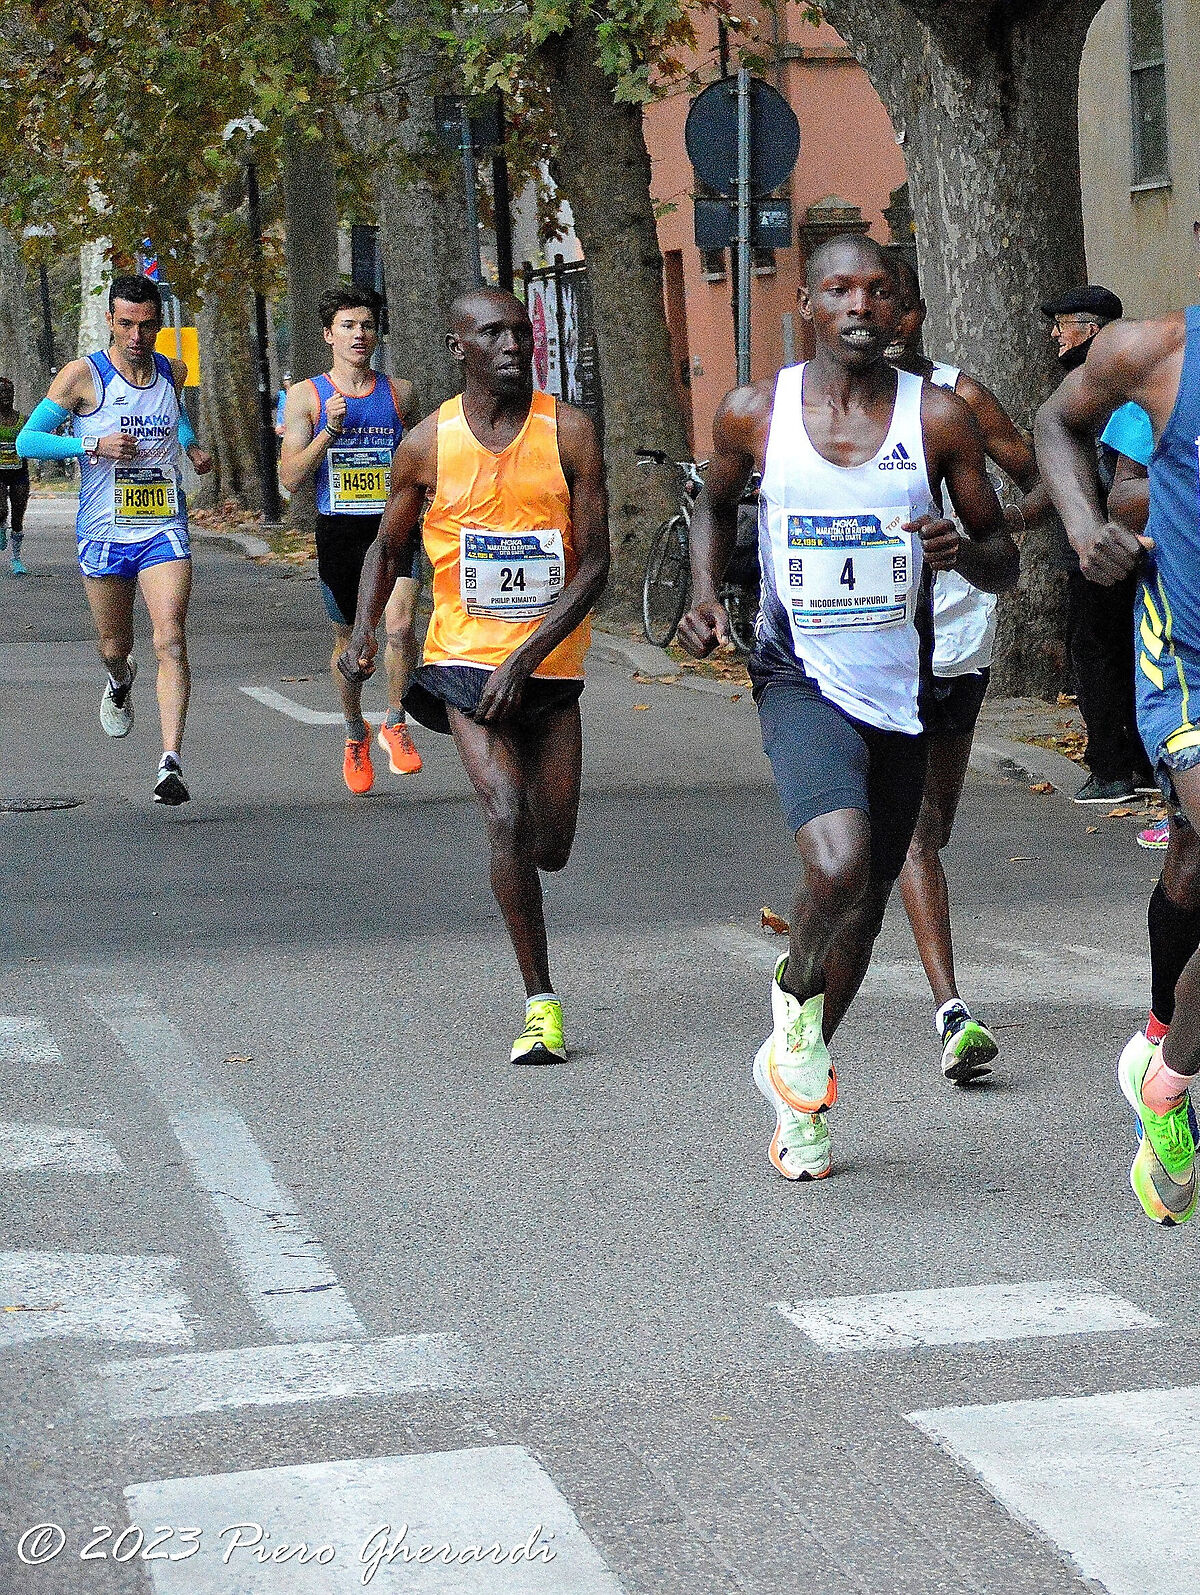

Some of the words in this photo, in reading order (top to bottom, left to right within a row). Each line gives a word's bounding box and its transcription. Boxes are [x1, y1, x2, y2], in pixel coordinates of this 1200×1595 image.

[120, 415, 170, 427] DINAMO
[878, 460, 917, 471] addas
[343, 472, 380, 491] H4581
[125, 488, 164, 507] H3010
[832, 519, 859, 528] HOKA
[885, 516, 900, 531] TOP
[500, 567, 527, 592] 24
[840, 557, 856, 591] 4
[511, 595, 537, 604] KIMAIYO
[810, 598, 853, 608] NICODEMUS
[854, 596, 888, 606] KIPKURUI
